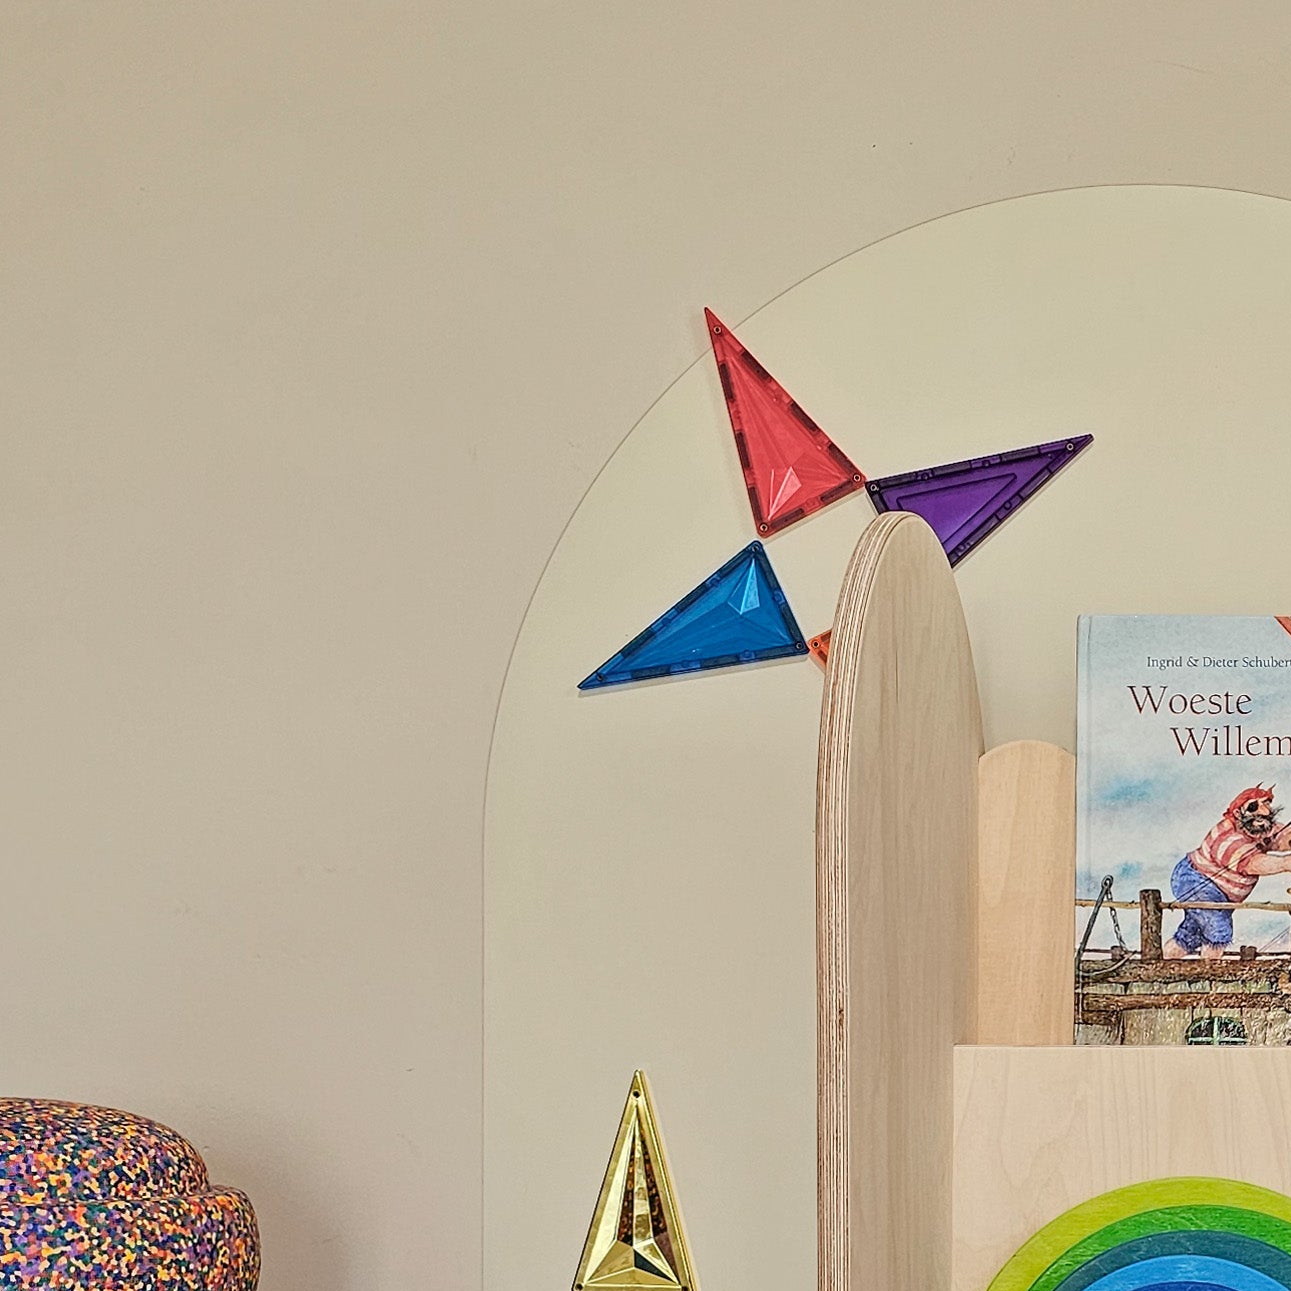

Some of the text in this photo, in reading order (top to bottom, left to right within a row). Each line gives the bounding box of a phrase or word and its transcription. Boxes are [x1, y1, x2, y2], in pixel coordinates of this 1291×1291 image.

[1147, 656, 1182, 670] Ingrid
[1186, 656, 1199, 668] &
[1203, 656, 1238, 668] Dieter
[1127, 685, 1252, 715] Woeste
